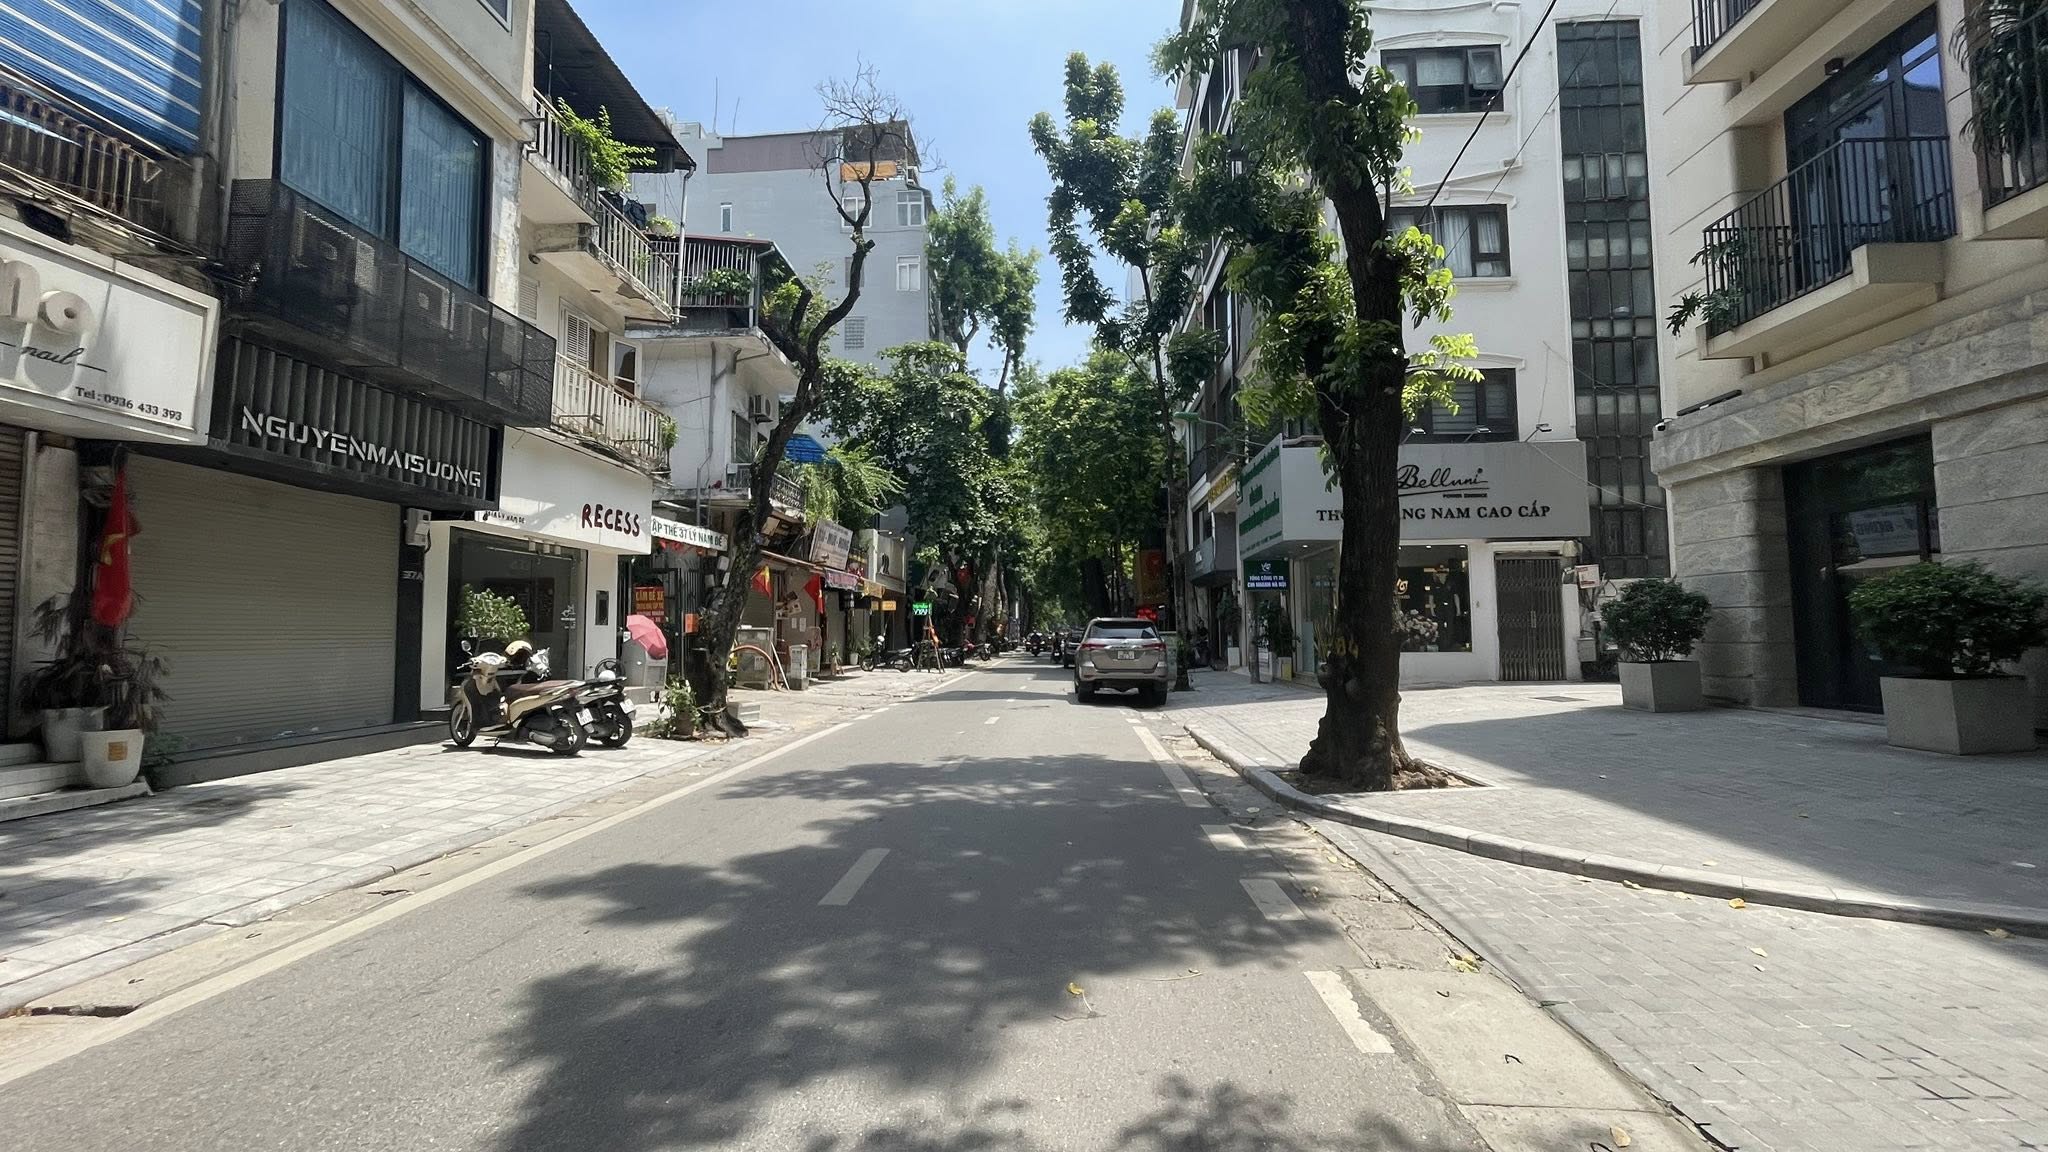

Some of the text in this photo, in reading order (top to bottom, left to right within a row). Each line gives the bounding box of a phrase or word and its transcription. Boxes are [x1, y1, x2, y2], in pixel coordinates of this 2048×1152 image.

[20, 346, 85, 366] nail
[103, 393, 134, 410] 0936
[138, 403, 159, 416] 433
[162, 408, 183, 421] 393
[241, 405, 481, 489] NGUYENMAISUONG
[581, 503, 641, 538] RECESS
[1316, 500, 1551, 522] TH NG NAM CAO CẤP
